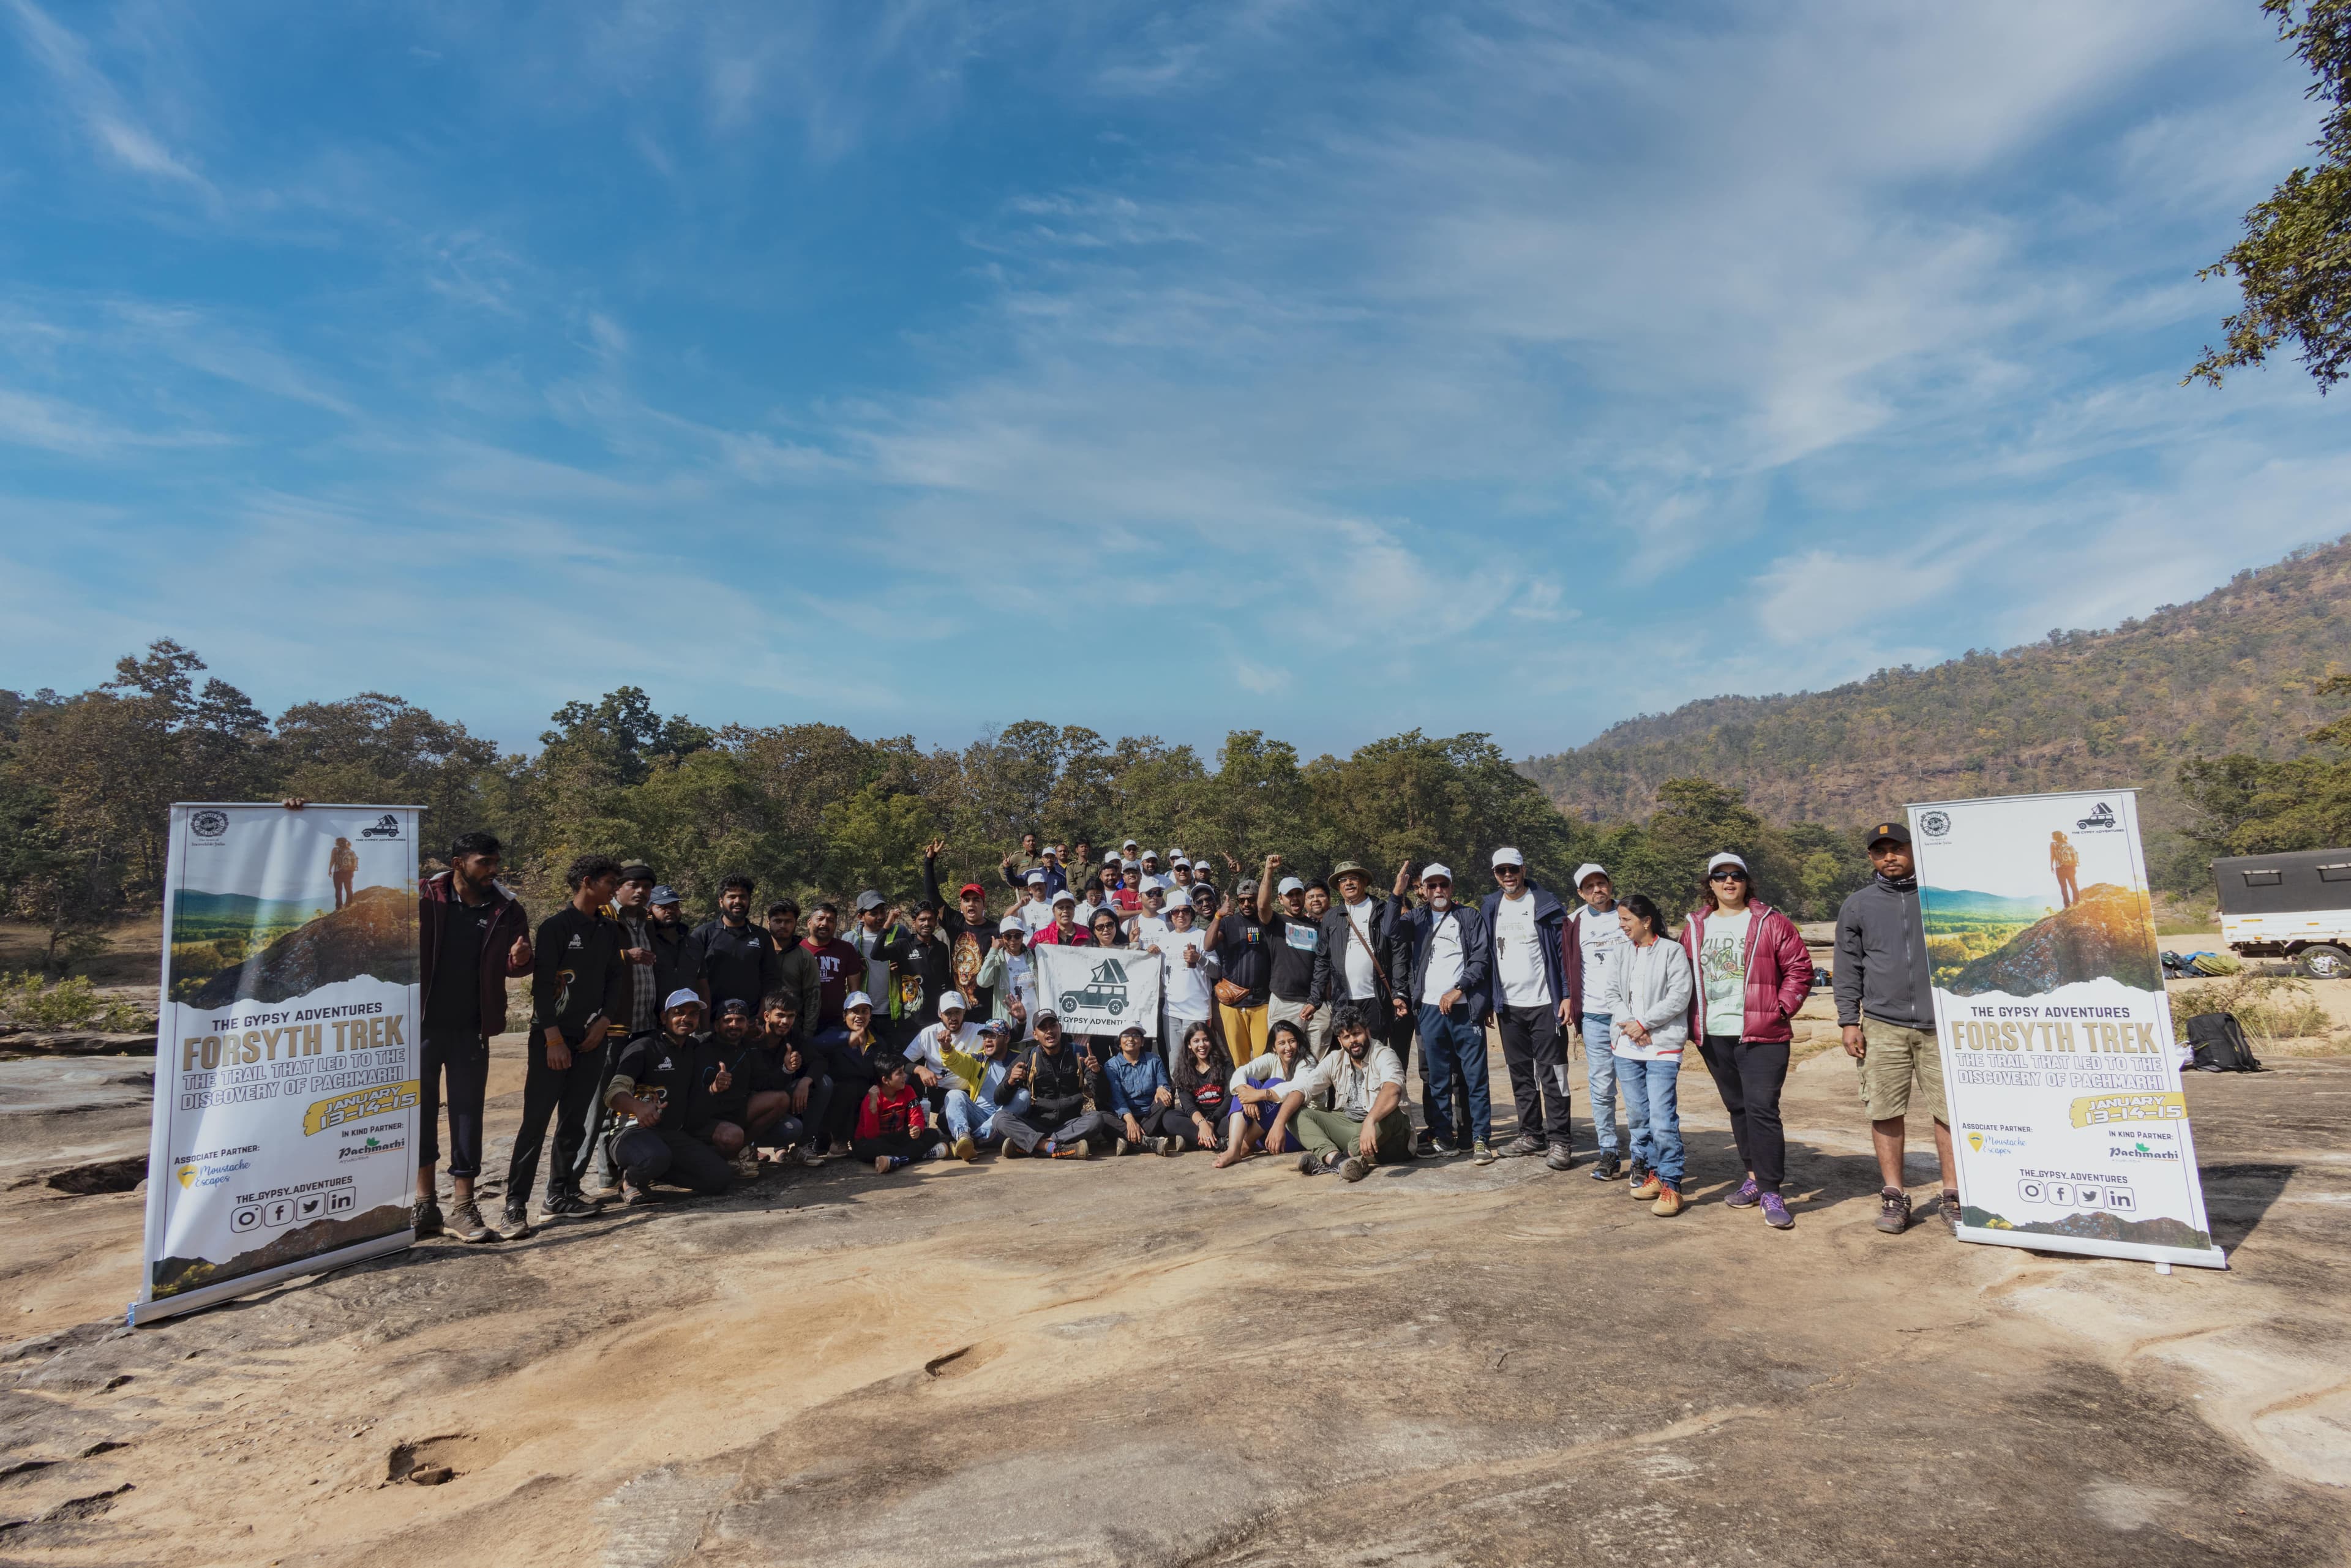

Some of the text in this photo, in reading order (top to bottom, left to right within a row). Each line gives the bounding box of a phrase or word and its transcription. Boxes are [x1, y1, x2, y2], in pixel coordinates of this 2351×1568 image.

[1248, 933, 1259, 942] OUT
[212, 1002, 382, 1031] THE GYPSY ADVENTURES
[1971, 1007, 2130, 1018] THE GYPSY ADVENTURES
[183, 1015, 405, 1071] FORSYTH TREK
[1951, 1021, 2159, 1053] FORSYTH TREK
[183, 1048, 405, 1090] THE TRAIL THAT LED TO THE
[1955, 1053, 2162, 1071] THE TRAIL THAT LED TO THE
[182, 1066, 403, 1110] DISCOVERY OF PACHMARHI
[1958, 1070, 2164, 1090] DISCOVERY OF PACHMARHI
[324, 1085, 403, 1114] JANUARY
[2088, 1096, 2165, 1111] JANUARY
[320, 1092, 416, 1130] 13-14-15
[2085, 1105, 2182, 1125] 13-14-15
[351, 1128, 367, 1136] KIND
[370, 1122, 404, 1133] PARTNER:
[1962, 1122, 1997, 1131] ASSOCIATE
[2137, 1131, 2173, 1140] PARTNER:
[339, 1138, 405, 1159] Pachmarhi
[1985, 1135, 2025, 1146] Moustache
[174, 1145, 260, 1165] ASSOCIATE PARTNER:
[2109, 1147, 2178, 1159] Pachmarhi
[200, 1159, 250, 1176] Moustache
[195, 1176, 230, 1188] Escapes
